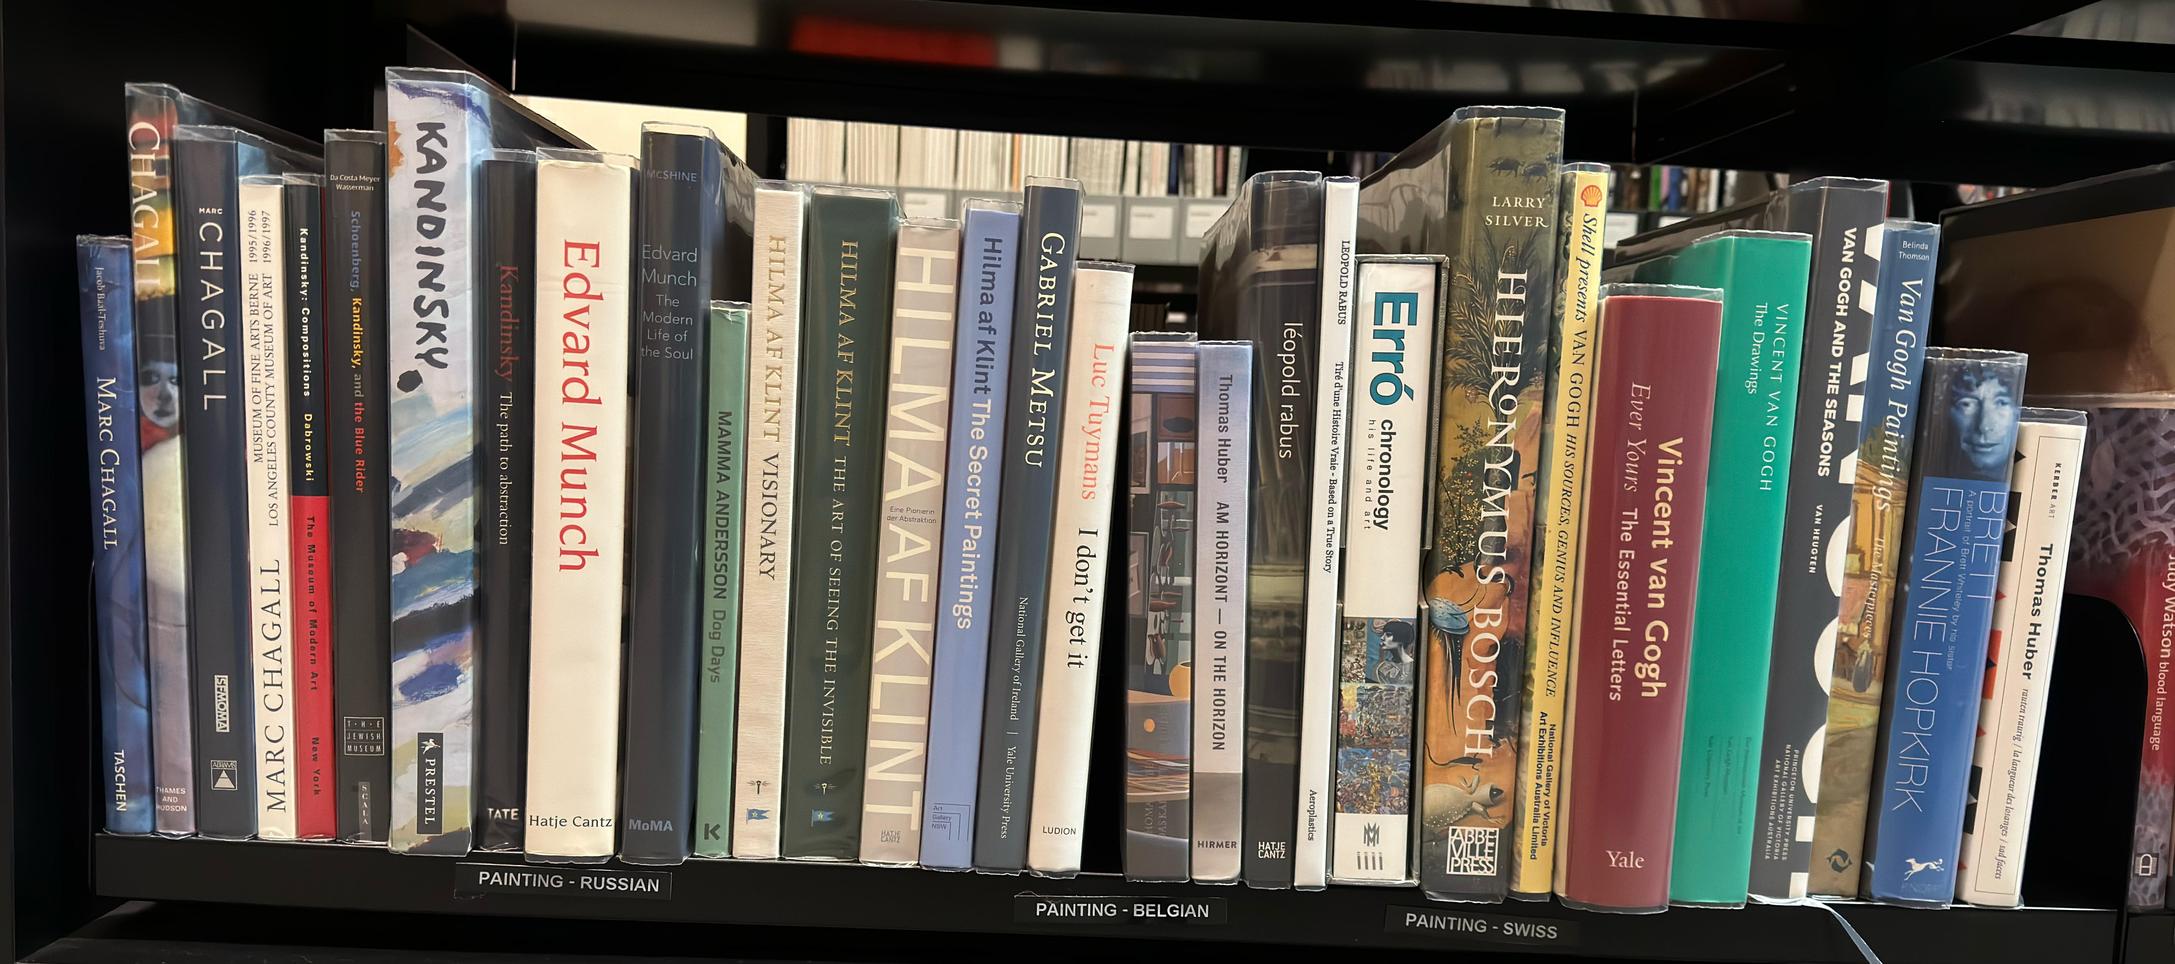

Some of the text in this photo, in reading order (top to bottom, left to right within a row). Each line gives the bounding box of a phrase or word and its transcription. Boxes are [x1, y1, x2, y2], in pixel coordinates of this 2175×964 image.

[128, 121, 161, 293] CHAGALL
[336, 184, 374, 192] Wasserman
[1485, 214, 1549, 228] SILVER
[1492, 196, 1546, 209] LARRY
[413, 121, 449, 369] KANDINSKY
[642, 244, 698, 263] Edvard
[642, 269, 697, 287] Munch
[1898, 251, 1930, 262] Thomson
[1902, 240, 1929, 250] Belinda
[199, 222, 227, 411] CHAGALL
[248, 210, 264, 463] MUSEUM OF FINE ARTS BERNE 1995/1996
[299, 228, 313, 481] Kandinsky: Compositions Dabrowski
[350, 211, 364, 493] Schoenberg, Kandinsky, and the Blue Rider
[642, 312, 693, 326] Modern
[642, 347, 694, 360] the Soul
[647, 329, 688, 343] Life of
[656, 295, 680, 308] The
[1023, 232, 1066, 468] GABRIEL METSU
[1369, 291, 1420, 406] Erró
[1744, 302, 1768, 395] The Drawings
[1817, 227, 1857, 477] VAN GOGH AND THE SEASONS
[262, 210, 279, 526] LOS ANGELES COUNTY MUSEUM OF ART 1996/1997
[495, 264, 520, 545] Kandinsky The path to abstraction
[559, 239, 604, 572] Edvard Munch
[759, 235, 786, 580] HILMA AF KLINT VISIONARY
[1277, 321, 1303, 459] léopold rabus
[1759, 303, 1789, 491] VINCENT VAN GOGH
[96, 377, 120, 550] MARC CHAGALL
[952, 237, 1003, 629] Hilma af Klint The Secret Paintings
[1363, 420, 1376, 530] his life and art
[1373, 419, 1397, 530] chronology
[1464, 268, 1528, 757] HIERONYMUS BOSCH
[1608, 381, 1652, 701] Ever Yours The Essential Letters
[1808, 504, 1823, 574] VAN HEUGTEN
[1967, 490, 2007, 600] BRETT
[2047, 462, 2062, 519] KERBER ART
[708, 411, 732, 683] MAMMA ANDERSSON Dog Days
[1212, 375, 1232, 751] Thomas Huber AM HORIZONT ON THE HORIZON
[1634, 437, 1684, 697] Vincent van Gogh
[306, 516, 318, 691] The Museum of Modern Art
[1892, 487, 1964, 813] FRANNIE HOPKIRK
[260, 559, 287, 813] MARC CHAGALL
[1000, 597, 1030, 839] National Gallery of Ireland Yale University Press
[114, 750, 127, 811] TASCHEN
[311, 737, 320, 796] New York
[424, 758, 436, 825] PRESTEL
[487, 807, 519, 822] TATE
[1307, 789, 1318, 841] Aeroplastics
[1530, 712, 1548, 860] Art Exhibitions Australia Limited
[1541, 724, 1556, 847] National Gallery of Victoria
[529, 815, 613, 831] Hatje Cantz
[629, 819, 673, 832] MoMA
[1042, 826, 1077, 836] LUDION
[1197, 840, 1237, 849] HIRMER
[1257, 850, 1286, 859] CANTZ
[1258, 841, 1286, 851] HATJE
[1606, 851, 1645, 869] Yale
[478, 871, 661, 893] PAINTING RUSSIAN
[1035, 903, 1210, 918] PAINTING BELGIAN
[1405, 913, 1558, 940] PAINTING SWISS
